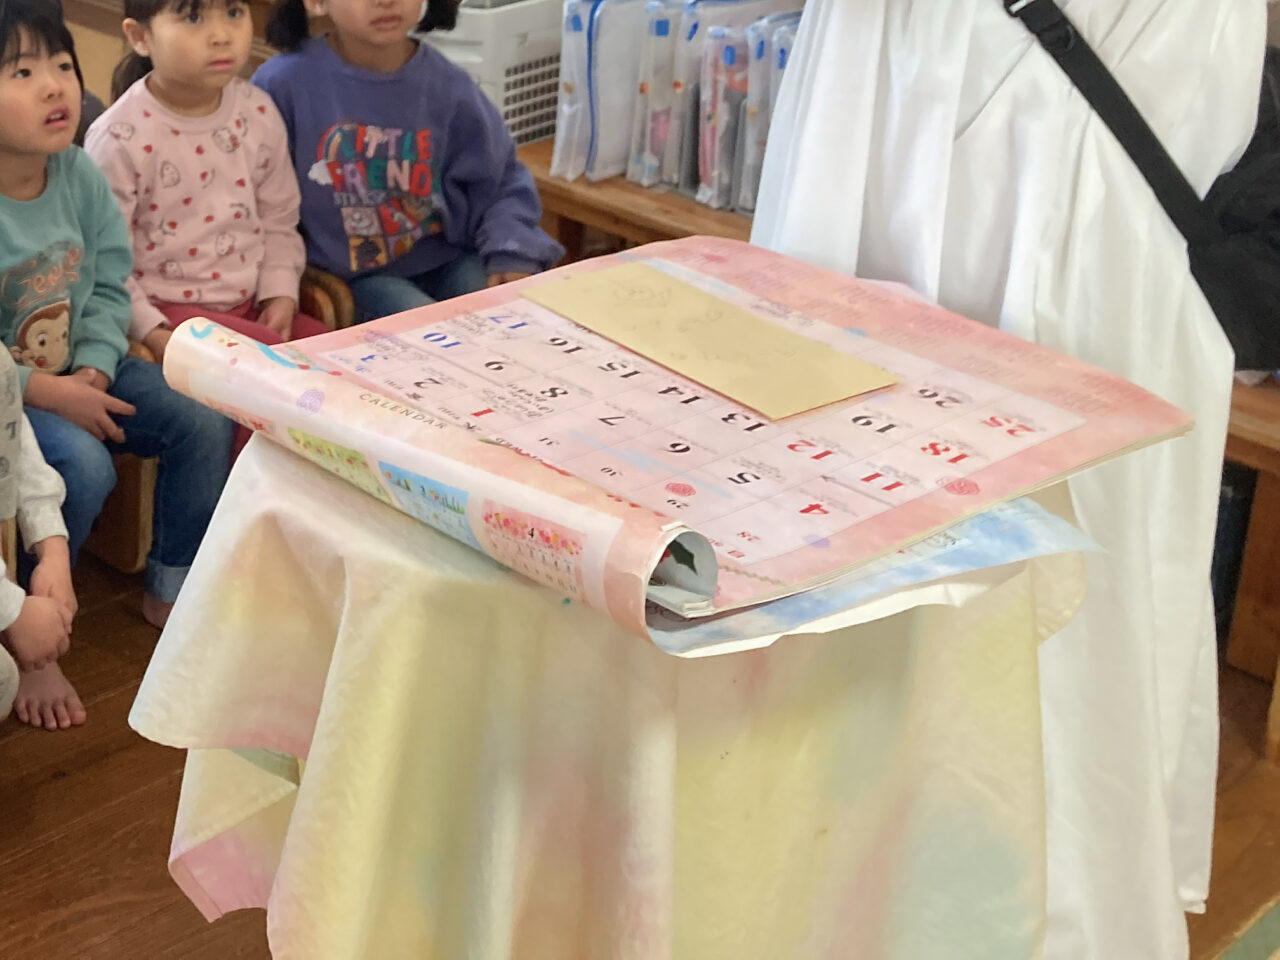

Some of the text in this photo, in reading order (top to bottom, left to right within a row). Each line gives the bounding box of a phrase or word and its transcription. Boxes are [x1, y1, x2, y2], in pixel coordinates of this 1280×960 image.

[340, 125, 432, 161] LITTLE
[326, 159, 432, 197] FRIEND
[488, 314, 528, 330] 17
[423, 332, 461, 348] 10
[548, 337, 584, 354] 16
[484, 361, 509, 371] 9
[598, 361, 641, 379] 15
[413, 378, 442, 389] 2
[541, 387, 569, 398] 8
[657, 386, 702, 404] 14
[918, 388, 963, 409] 26
[358, 393, 448, 430] CALENDAR
[472, 408, 495, 417] 1
[598, 415, 626, 426] 7
[721, 412, 767, 432] 13
[851, 415, 897, 434] 19
[981, 416, 1035, 438] 25
[665, 442, 691, 453] 6
[786, 439, 834, 460] 12
[920, 442, 970, 464] 18
[728, 472, 761, 484] 5
[860, 472, 904, 491] 11
[666, 499, 690, 510] 29
[798, 503, 829, 515] 4
[528, 527, 536, 539] 4
[736, 530, 760, 542] 28
